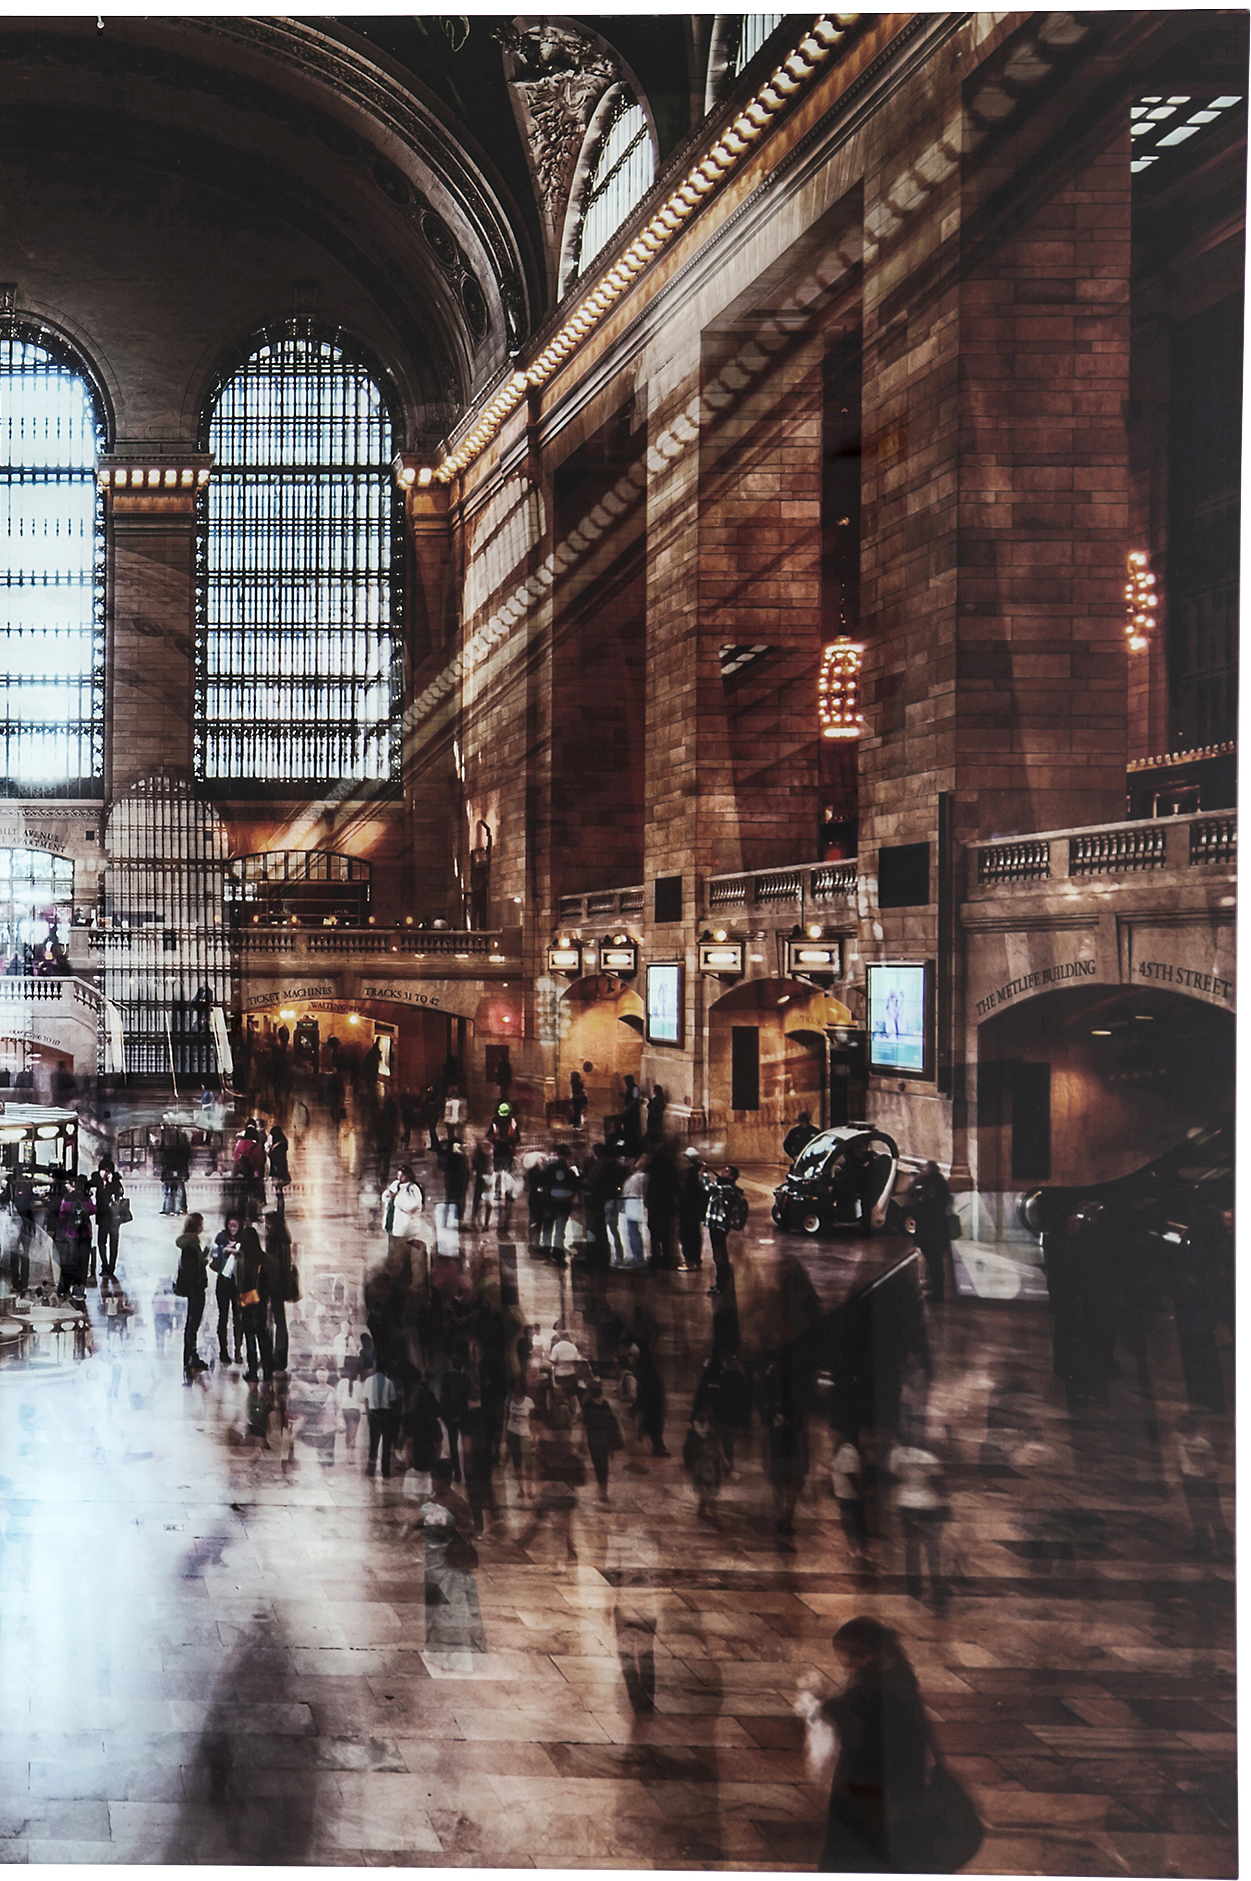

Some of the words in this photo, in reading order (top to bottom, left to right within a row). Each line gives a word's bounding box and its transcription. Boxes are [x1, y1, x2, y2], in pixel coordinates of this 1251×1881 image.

[12, 837, 66, 853] APARTMENT
[23, 829, 59, 843] AVENUE
[975, 994, 996, 1016] THE
[996, 972, 1040, 1003] METLIFE
[1042, 960, 1096, 984] BUILDING
[1139, 961, 1173, 982] 45TH
[1176, 967, 1232, 999] STREET
[248, 992, 280, 1006] TICKET
[283, 986, 333, 999] MACHINES
[365, 987, 401, 999] TRACKS
[404, 992, 413, 1001] 31
[415, 993, 428, 1004] TO
[429, 997, 440, 1007] 42
[311, 1001, 347, 1012] WAITING
